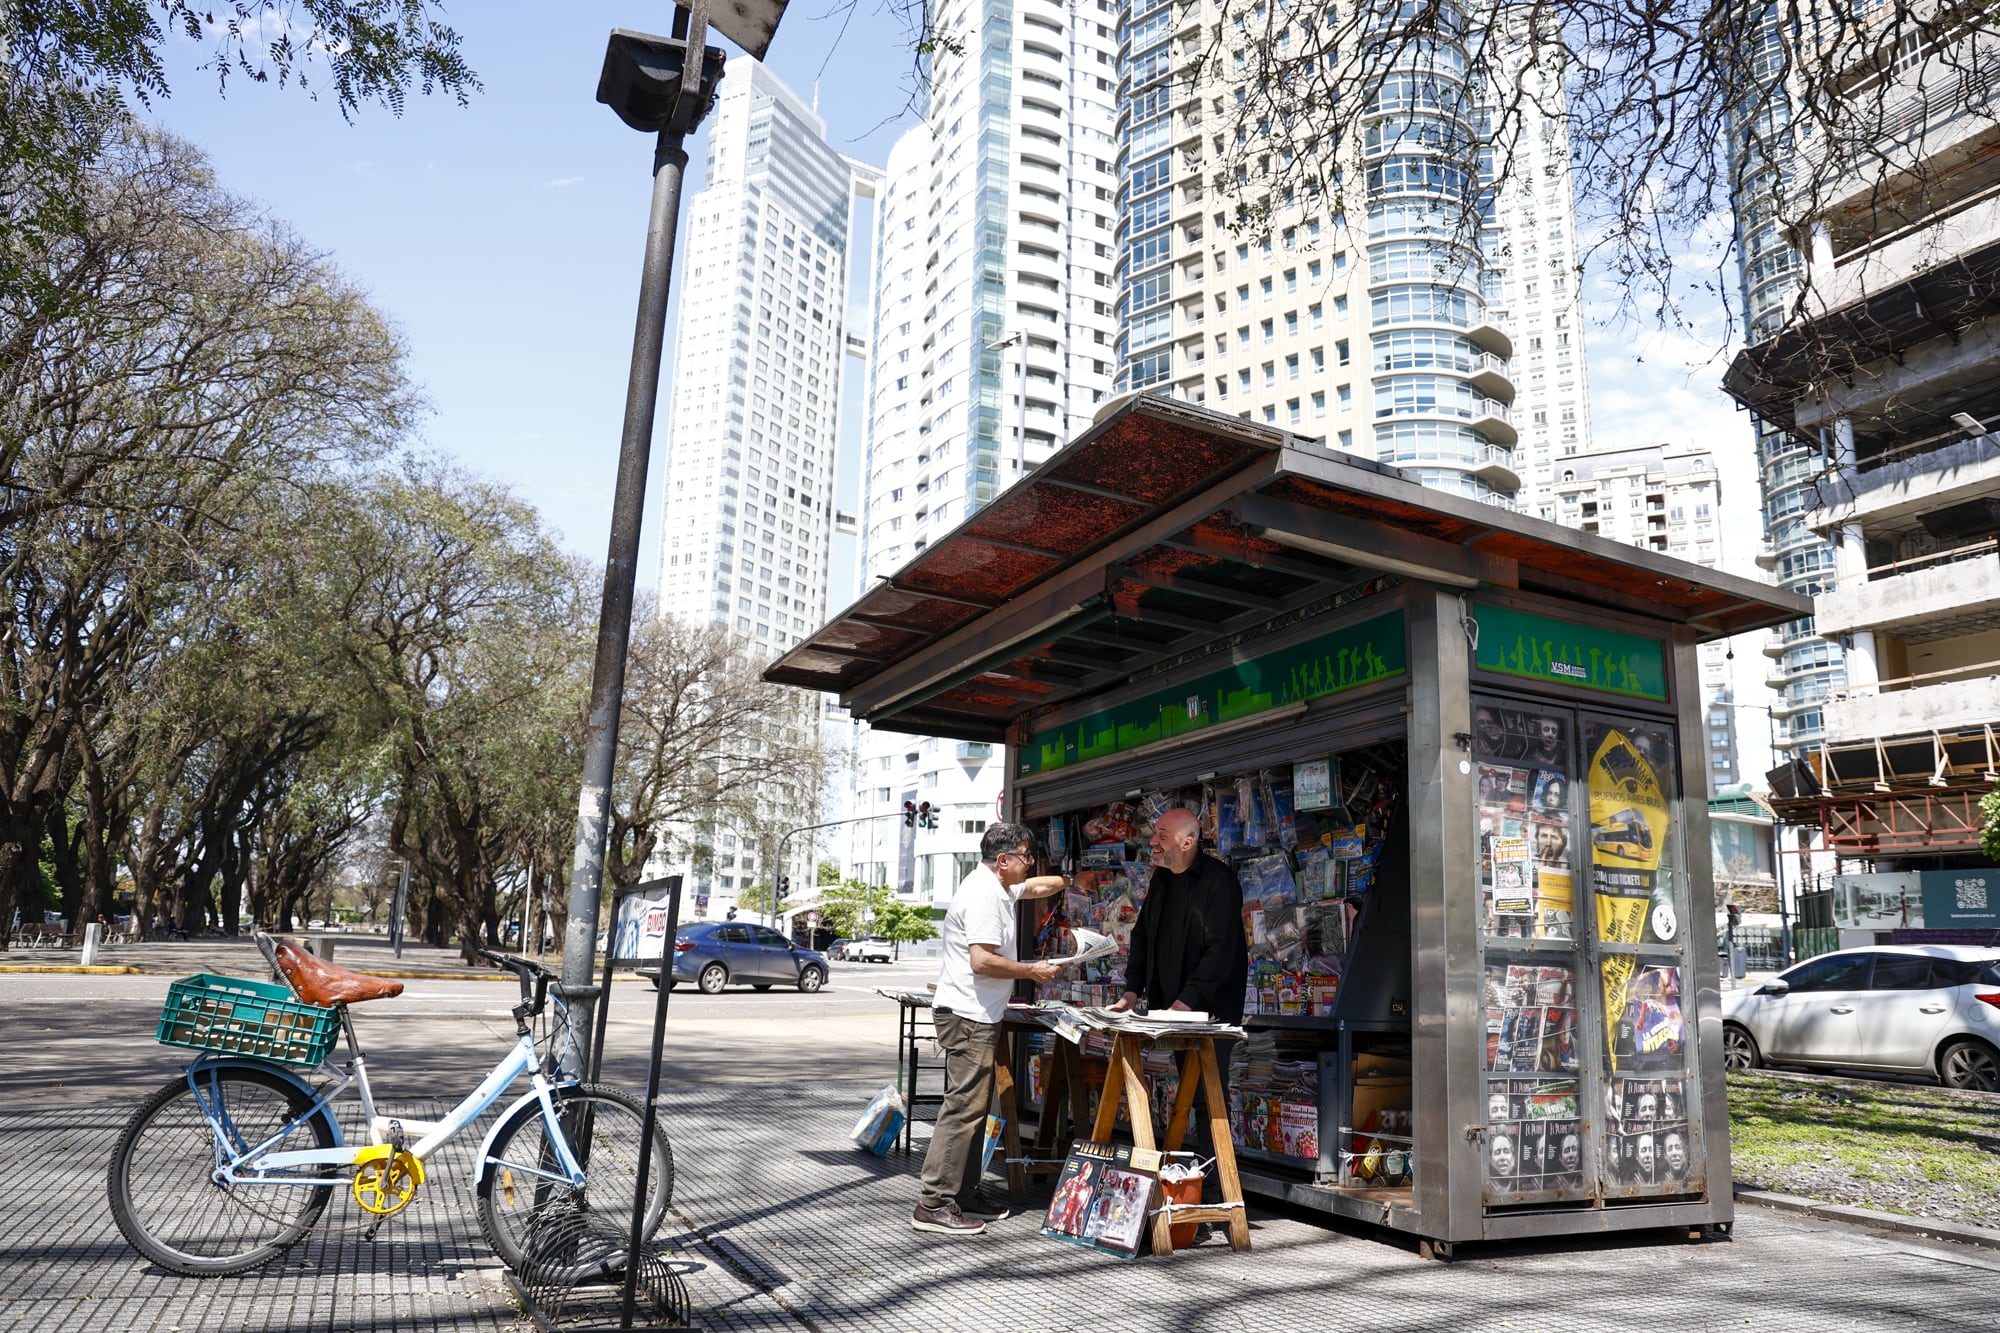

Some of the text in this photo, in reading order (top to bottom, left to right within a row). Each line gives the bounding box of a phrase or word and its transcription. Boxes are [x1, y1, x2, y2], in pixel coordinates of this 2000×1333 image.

[1551, 661, 1571, 673] VSM
[1593, 791, 1662, 808] BUENOS AIRES BUS
[646, 911, 667, 933] BIMBO
[1627, 902, 1641, 930] AIRES
